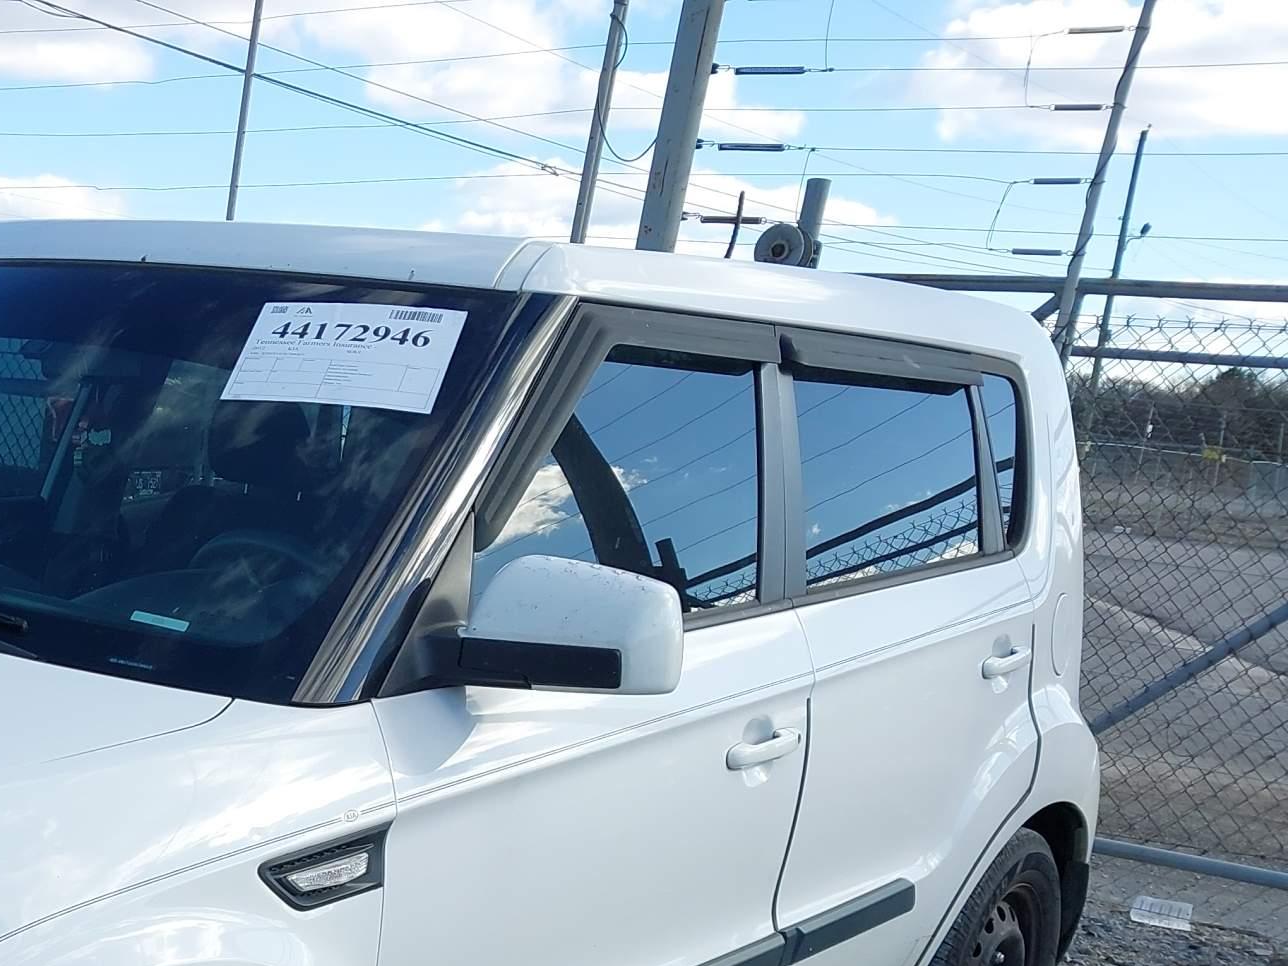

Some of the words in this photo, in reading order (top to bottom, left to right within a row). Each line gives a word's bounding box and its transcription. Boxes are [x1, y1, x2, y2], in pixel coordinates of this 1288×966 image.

[272, 321, 433, 348] 44172946
[332, 341, 373, 349] Insurance
[346, 812, 357, 820] KIA
